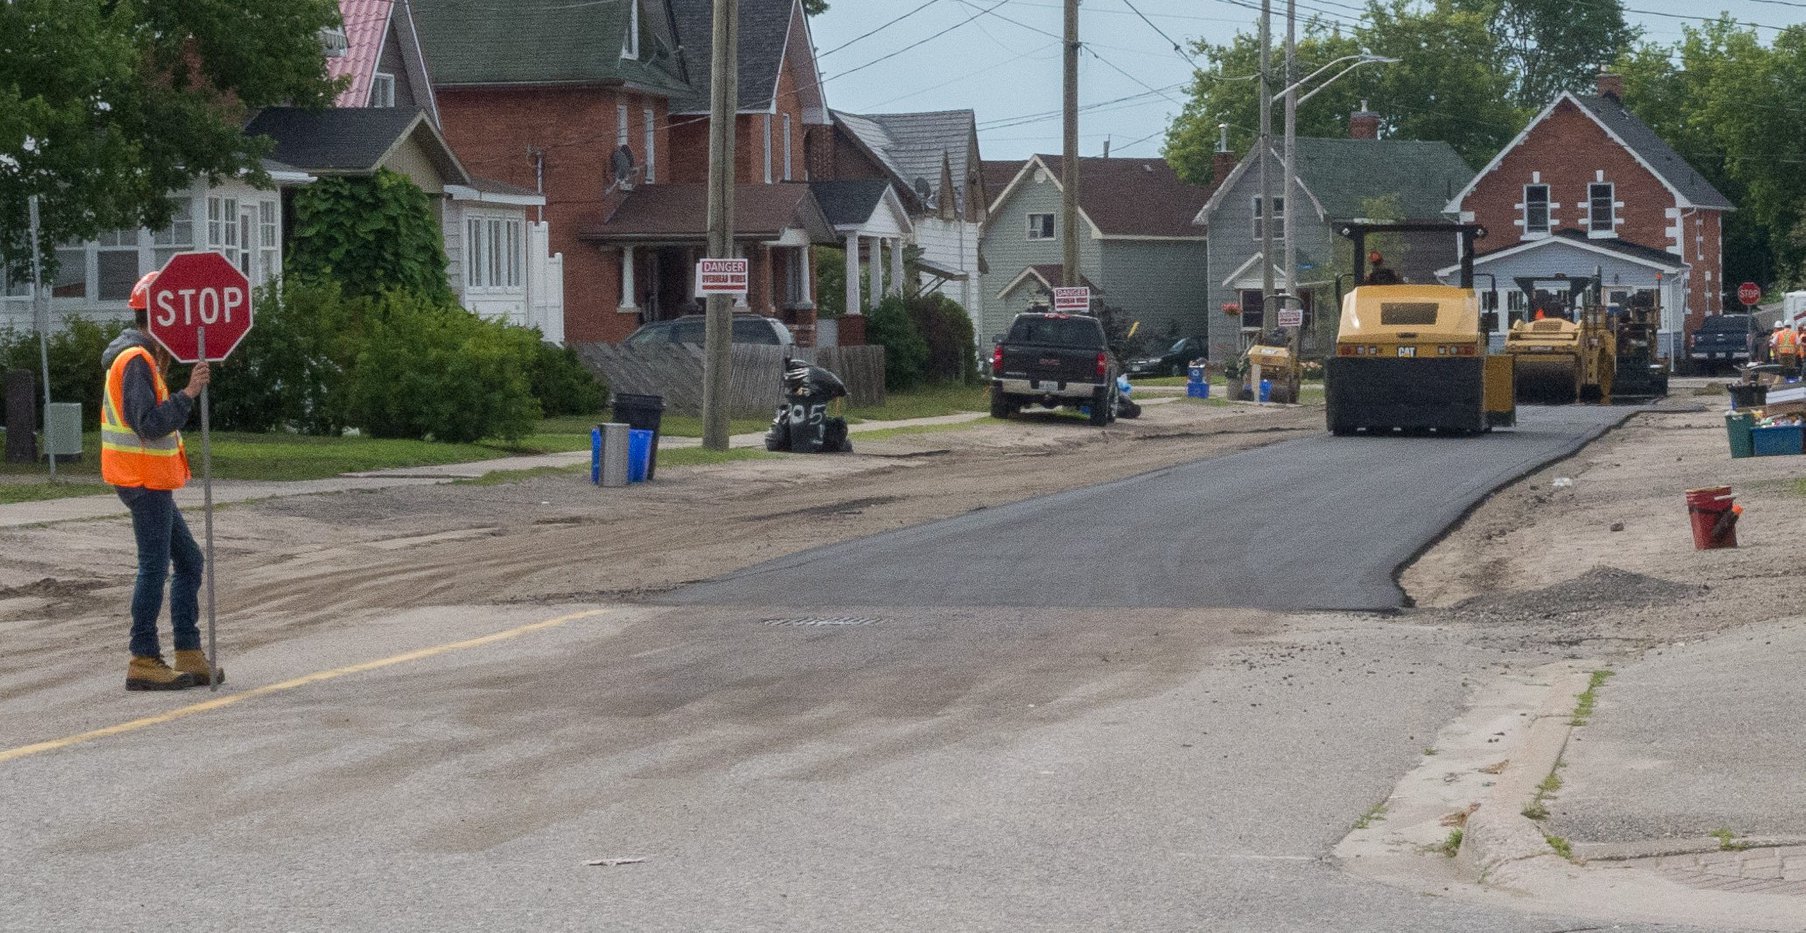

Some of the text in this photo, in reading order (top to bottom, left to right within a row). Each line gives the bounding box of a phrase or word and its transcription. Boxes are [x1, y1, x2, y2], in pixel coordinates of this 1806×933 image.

[704, 262, 744, 271] DANGER
[1740, 289, 1758, 298] STOP
[156, 286, 243, 327] STOP
[1398, 347, 1414, 357] CAT
